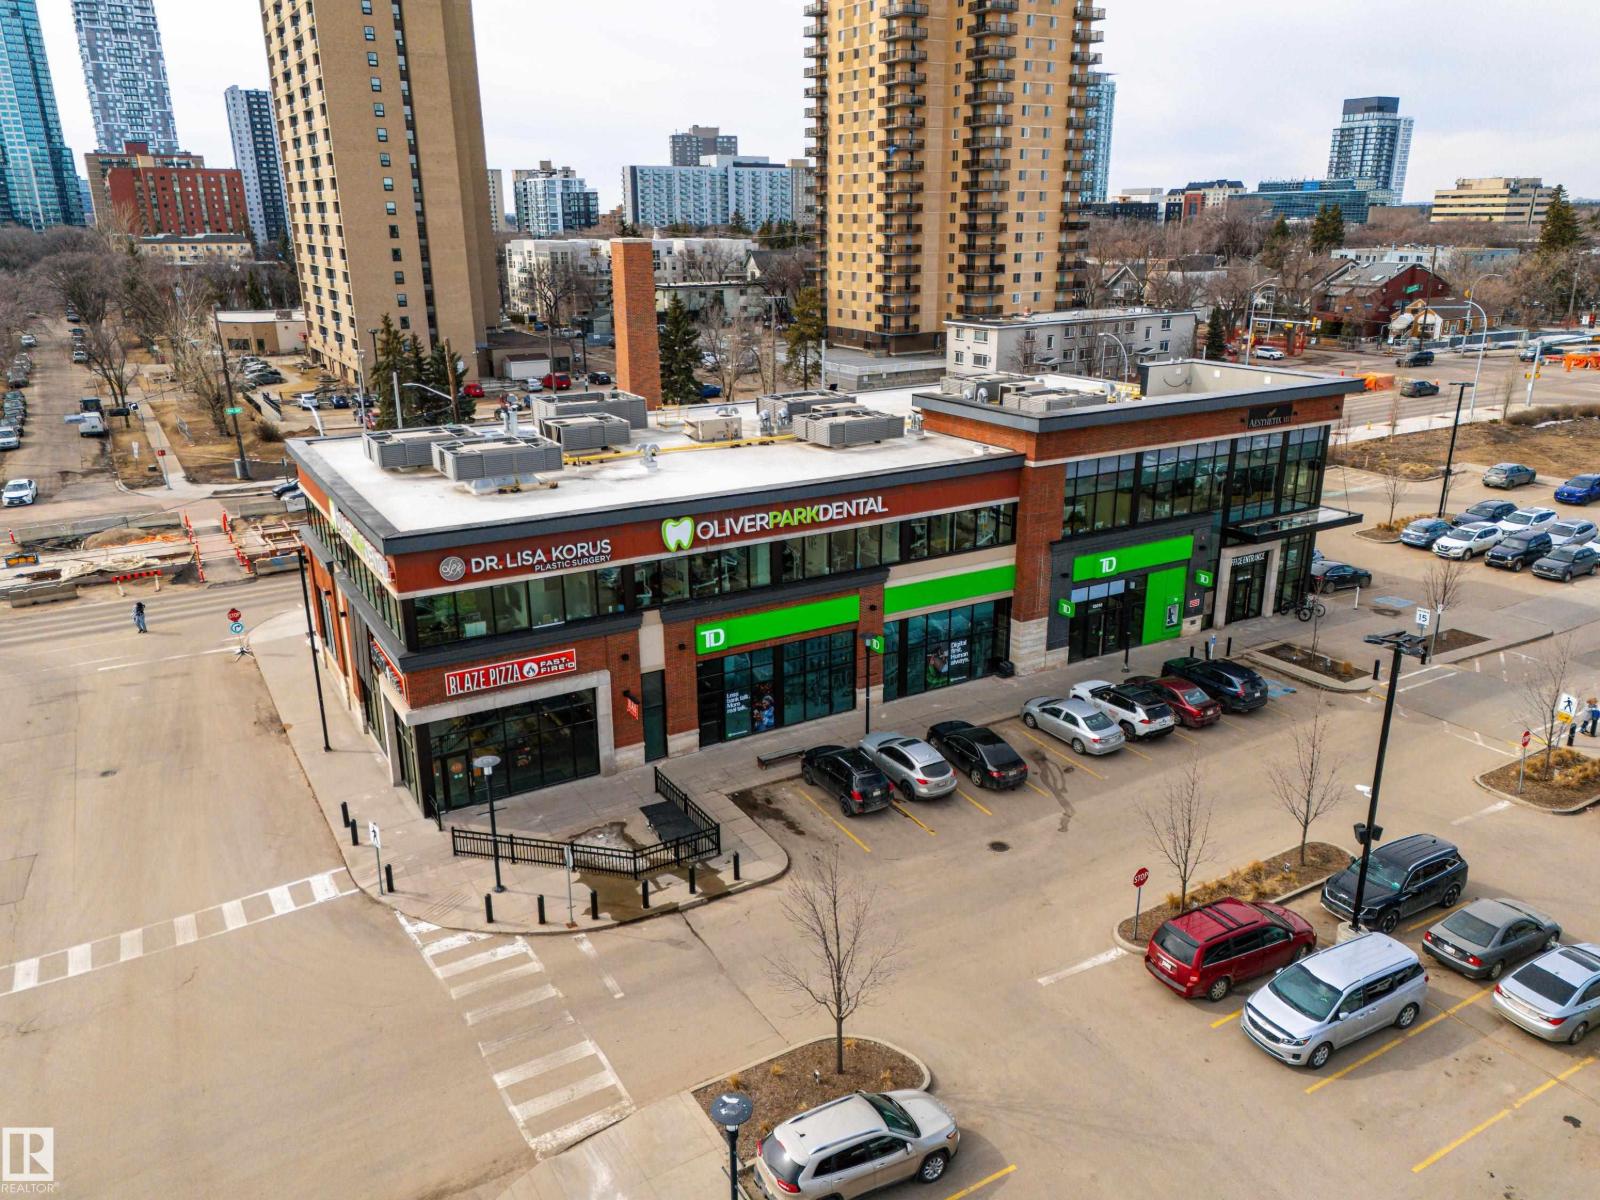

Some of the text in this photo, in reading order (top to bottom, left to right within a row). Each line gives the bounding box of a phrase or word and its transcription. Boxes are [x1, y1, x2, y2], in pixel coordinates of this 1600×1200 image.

[471, 539, 612, 574] DR. LISA KORUS
[534, 554, 611, 572] PLASTIC SURGERY
[1099, 556, 1117, 574] TD
[1199, 573, 1209, 584] TD
[1062, 603, 1071, 614] TD
[1419, 614, 1427, 622] 15
[701, 628, 725, 649] TD
[872, 638, 880, 650] TD
[950, 640, 967, 649] Digital
[950, 652, 969, 660] Human
[449, 663, 520, 695] BLAZE PIZZA
[1134, 872, 1149, 883] STOP
